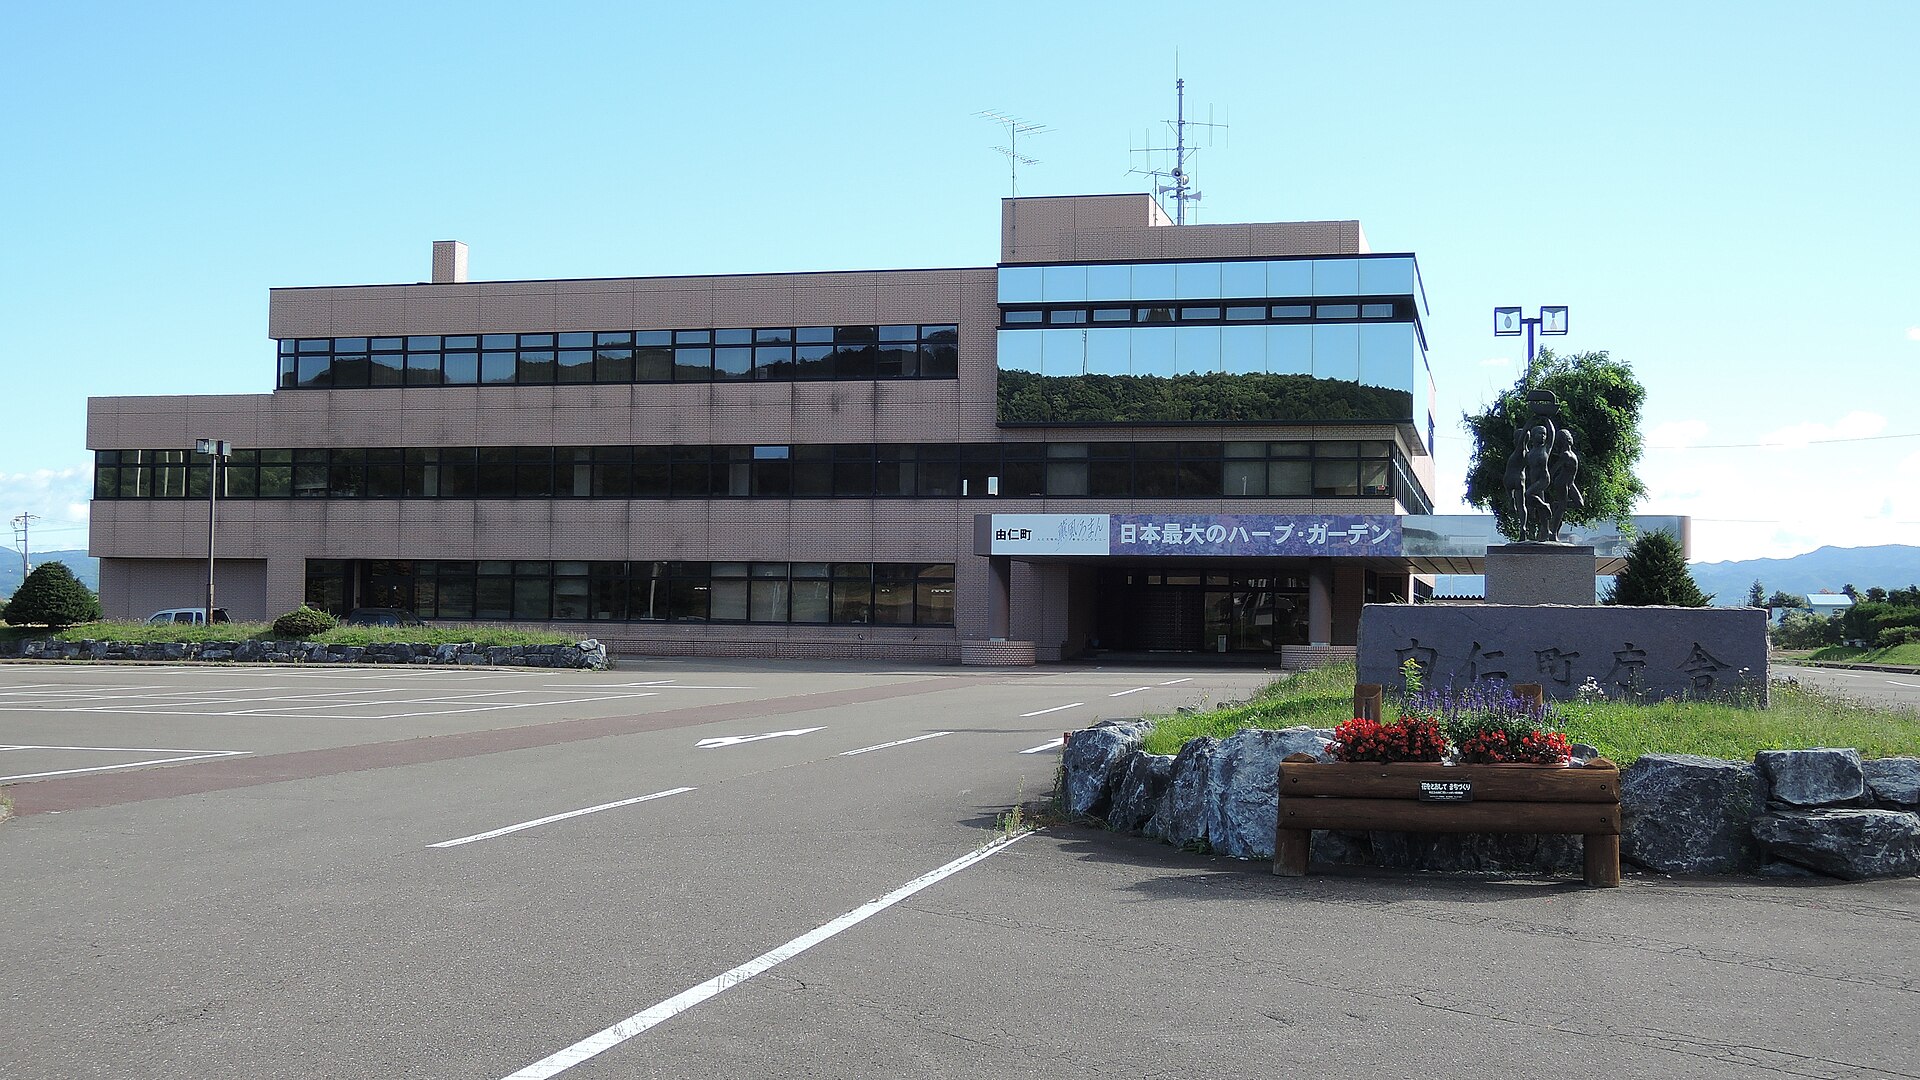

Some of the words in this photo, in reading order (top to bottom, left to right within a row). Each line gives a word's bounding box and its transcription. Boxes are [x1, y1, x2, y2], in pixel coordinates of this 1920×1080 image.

[995, 528, 1032, 541] 由仁町
[1120, 523, 1391, 544] 日本最大のハーブ・ガーデン
[1395, 638, 1732, 690] 由仁町庁舎
